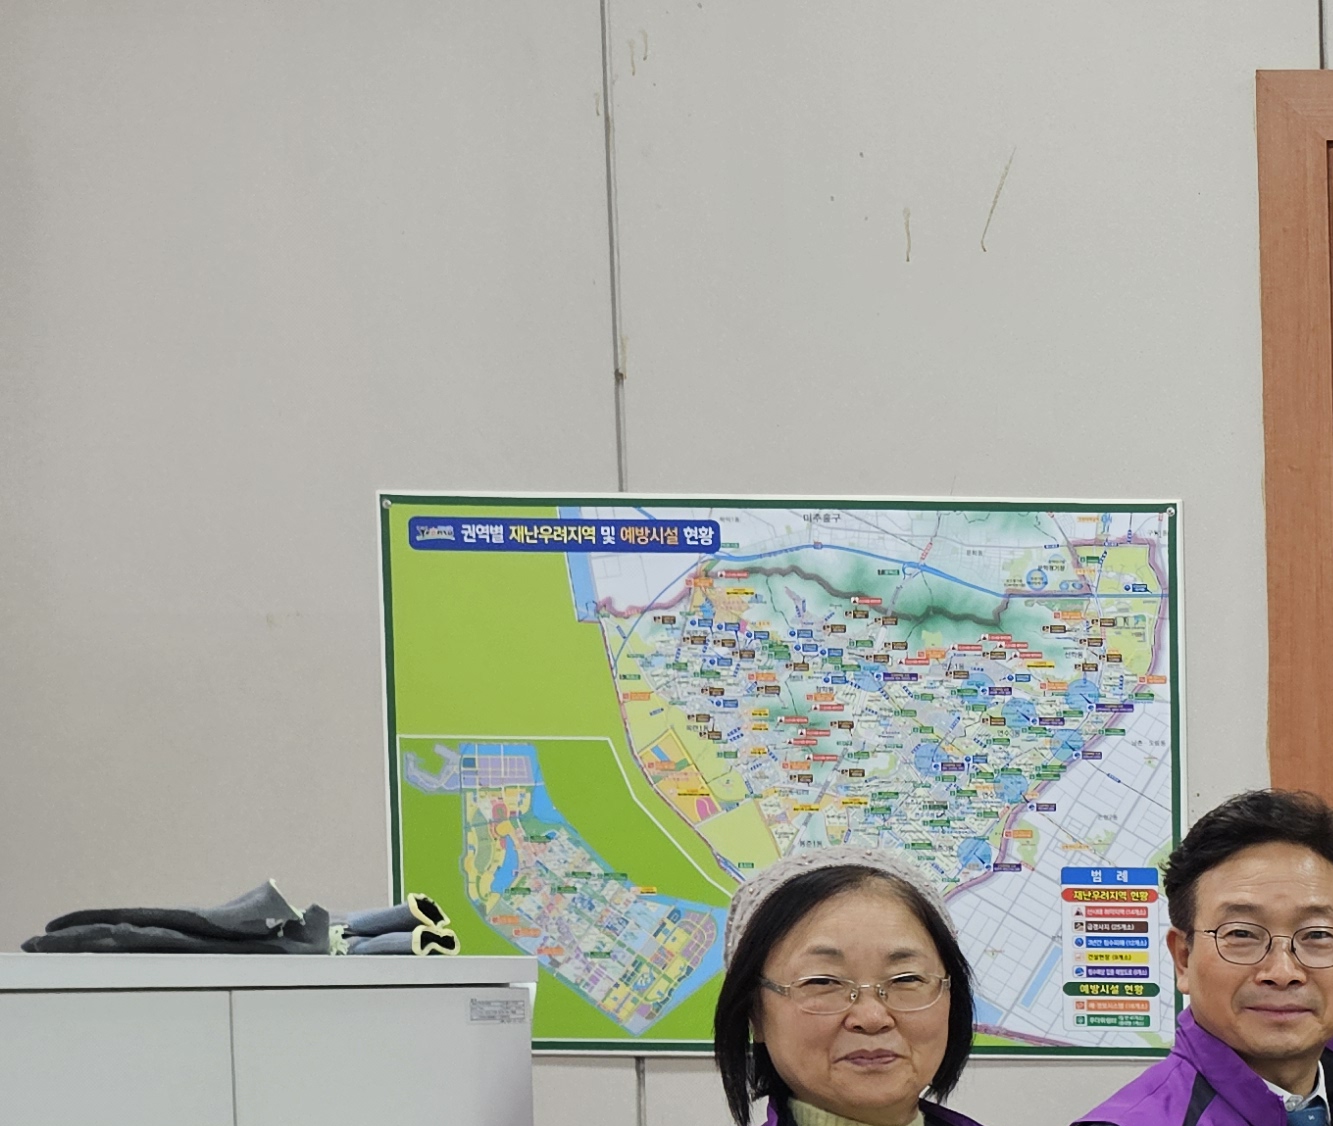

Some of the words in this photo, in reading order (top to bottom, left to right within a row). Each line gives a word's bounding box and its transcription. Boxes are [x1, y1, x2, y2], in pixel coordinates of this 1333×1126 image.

[461, 524, 504, 544] 권역별
[508, 524, 596, 545] 재난우려지역
[600, 526, 617, 545] 및
[620, 525, 679, 545] 예방시설
[683, 526, 715, 546] 현황
[1073, 890, 1127, 901] 재난우려지역
[1130, 891, 1149, 902] 현황
[1079, 984, 1119, 995] 예방시설
[1124, 985, 1144, 995] 현황
